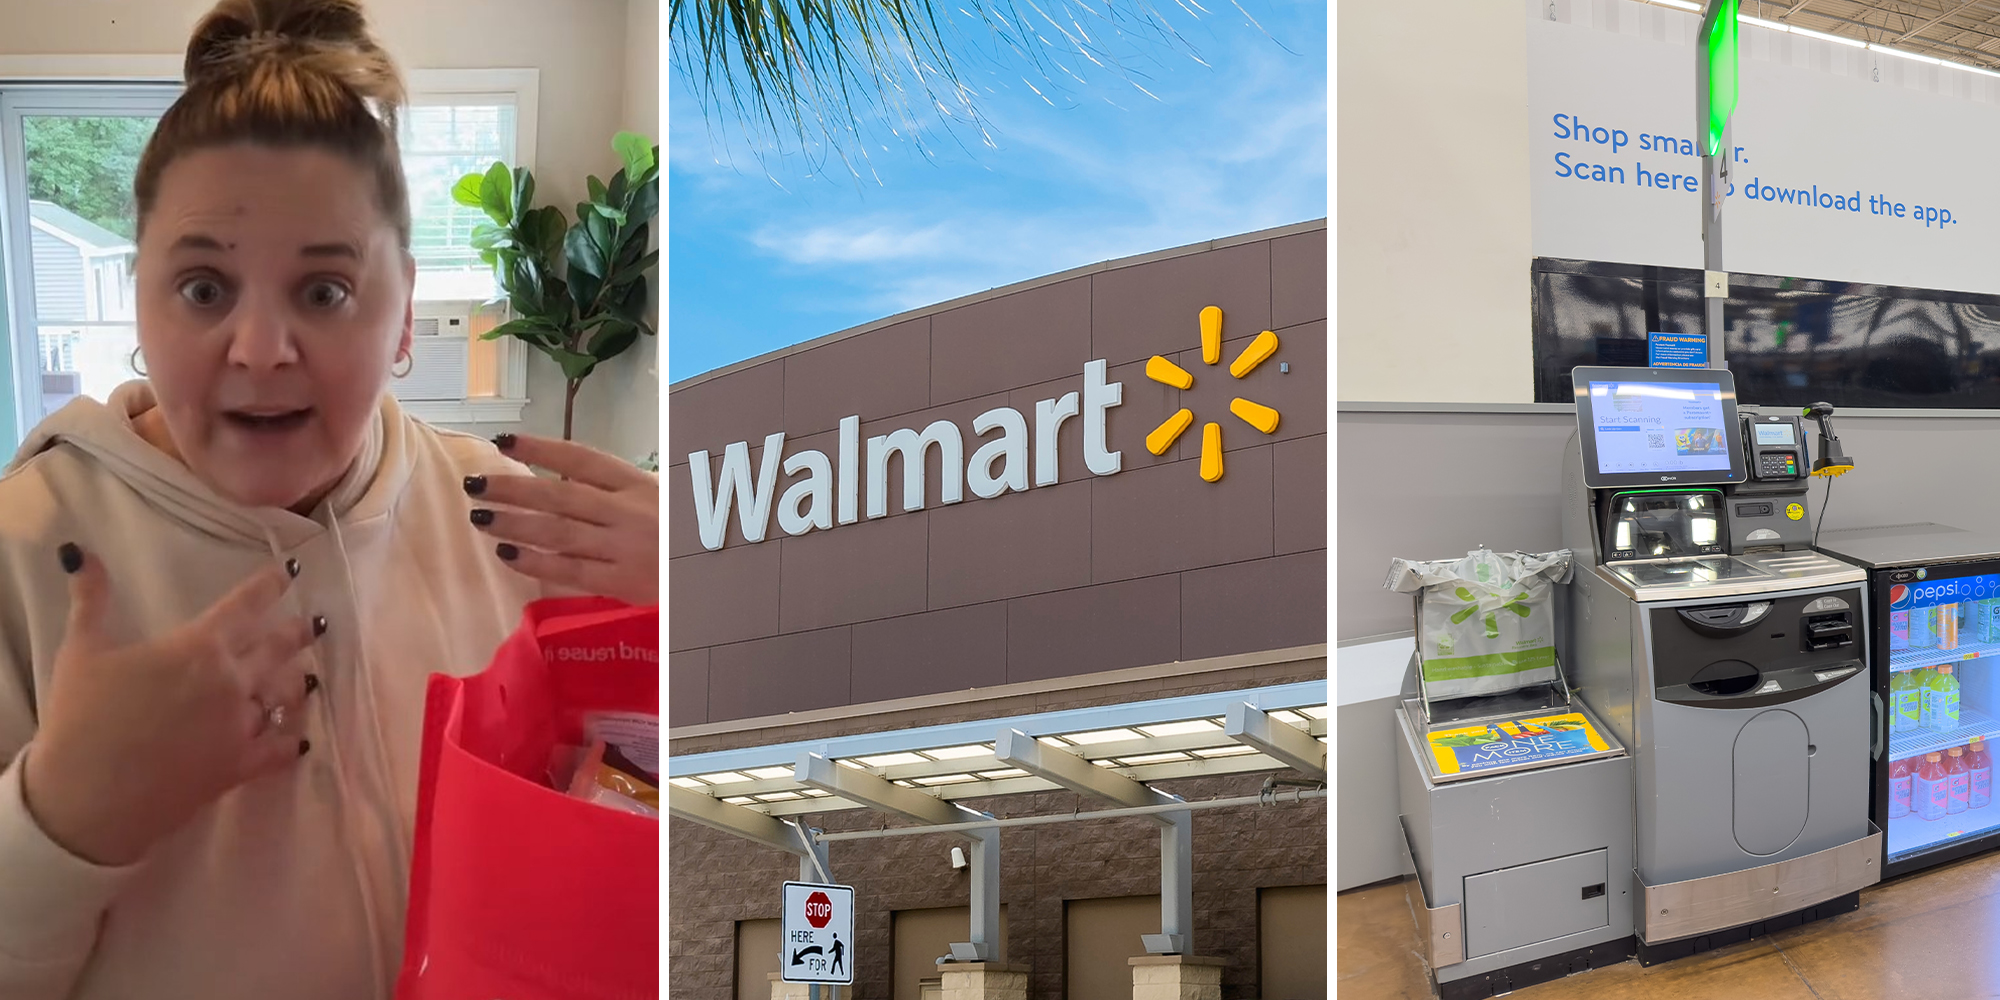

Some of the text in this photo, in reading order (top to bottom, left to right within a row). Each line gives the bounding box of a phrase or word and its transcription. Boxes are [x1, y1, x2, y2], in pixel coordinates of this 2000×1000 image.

[1553, 113, 1629, 153] Shop
[1720, 148, 1728, 184] 4
[1554, 152, 1625, 184] Scan
[1636, 163, 1698, 192] here
[1744, 177, 1861, 213] download
[1869, 194, 1906, 218] the
[1913, 204, 1957, 229] app.
[1623, 415, 1662, 424] Scanning
[688, 358, 1123, 551] Walmart
[1914, 581, 1958, 604] pepsi
[1473, 740, 1576, 761] MORE
[807, 902, 831, 918] STOP
[791, 930, 814, 943] HERE
[809, 958, 827, 971] FOR
